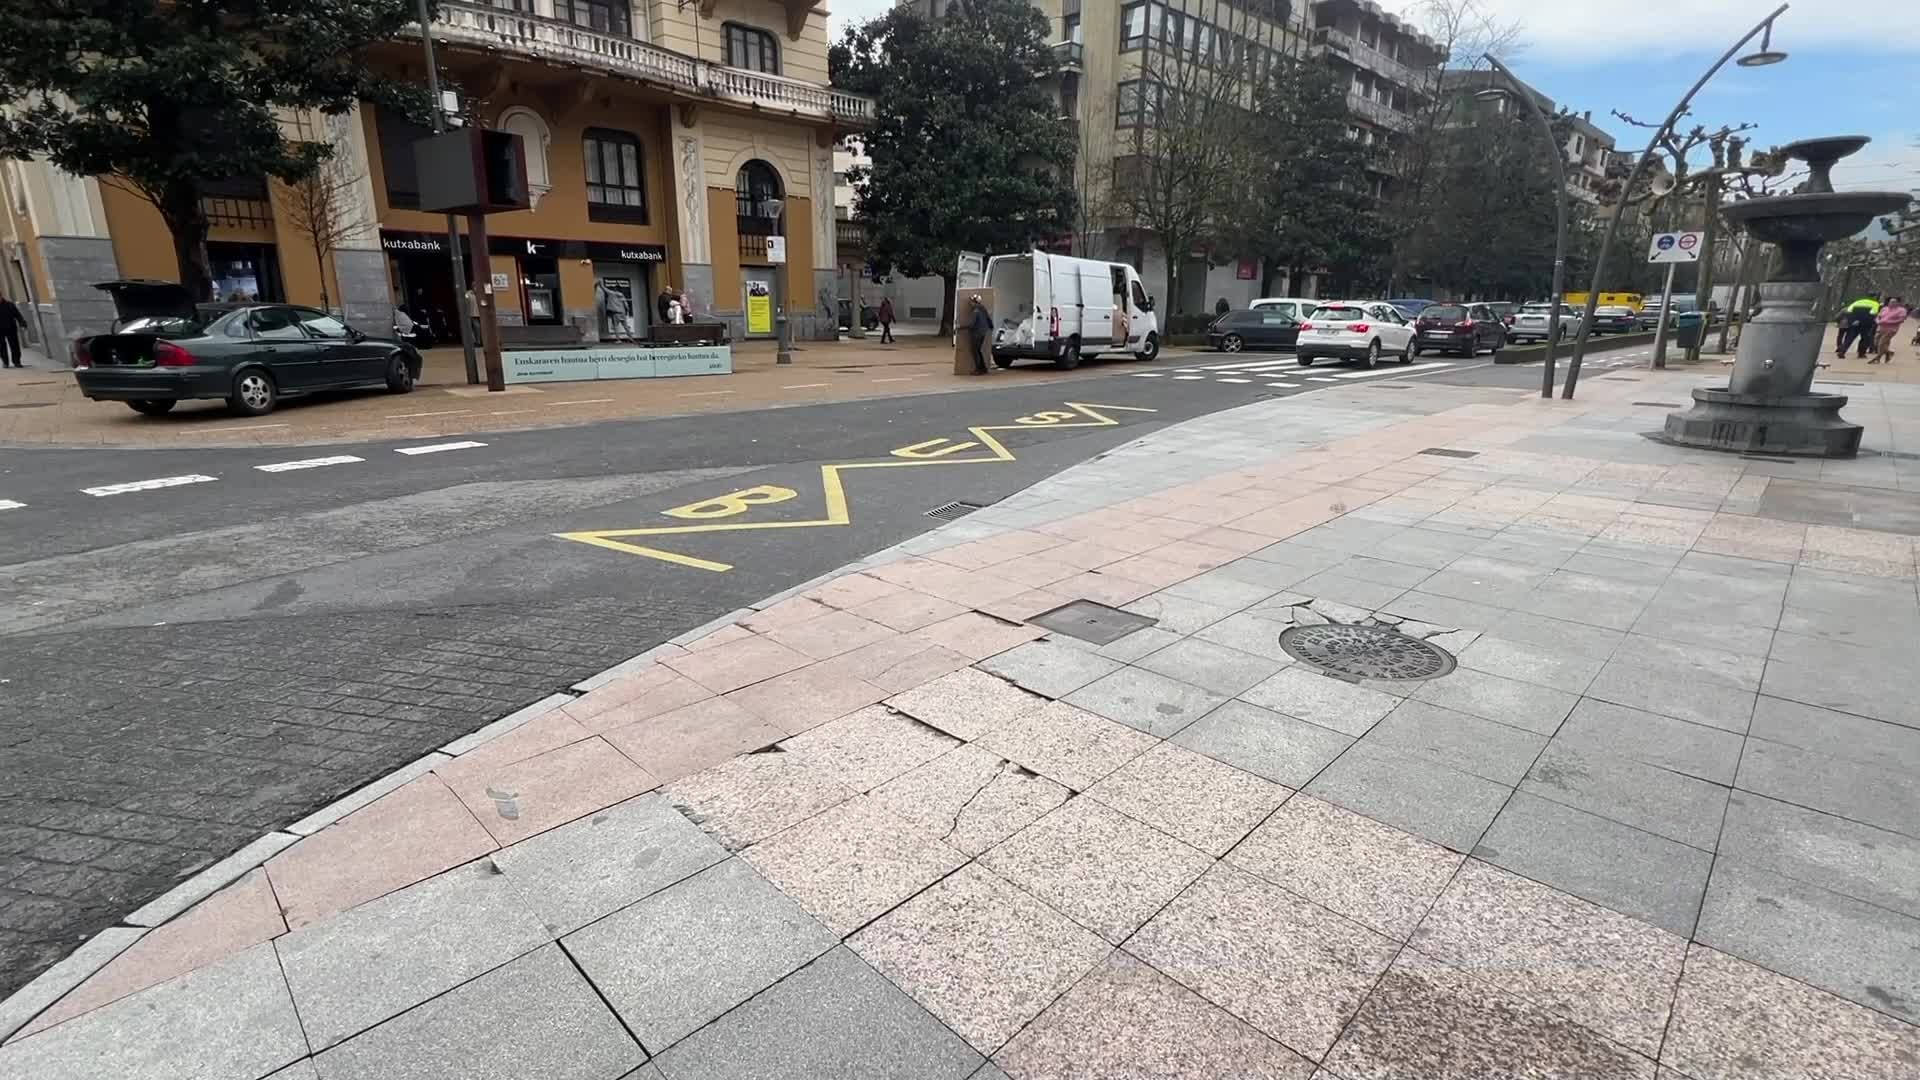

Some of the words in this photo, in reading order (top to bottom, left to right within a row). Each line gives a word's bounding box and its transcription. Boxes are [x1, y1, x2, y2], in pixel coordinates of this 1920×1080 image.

[383, 238, 440, 250] kutxabank
[621, 250, 663, 260] kutxabank
[514, 356, 560, 365] Euskararen
